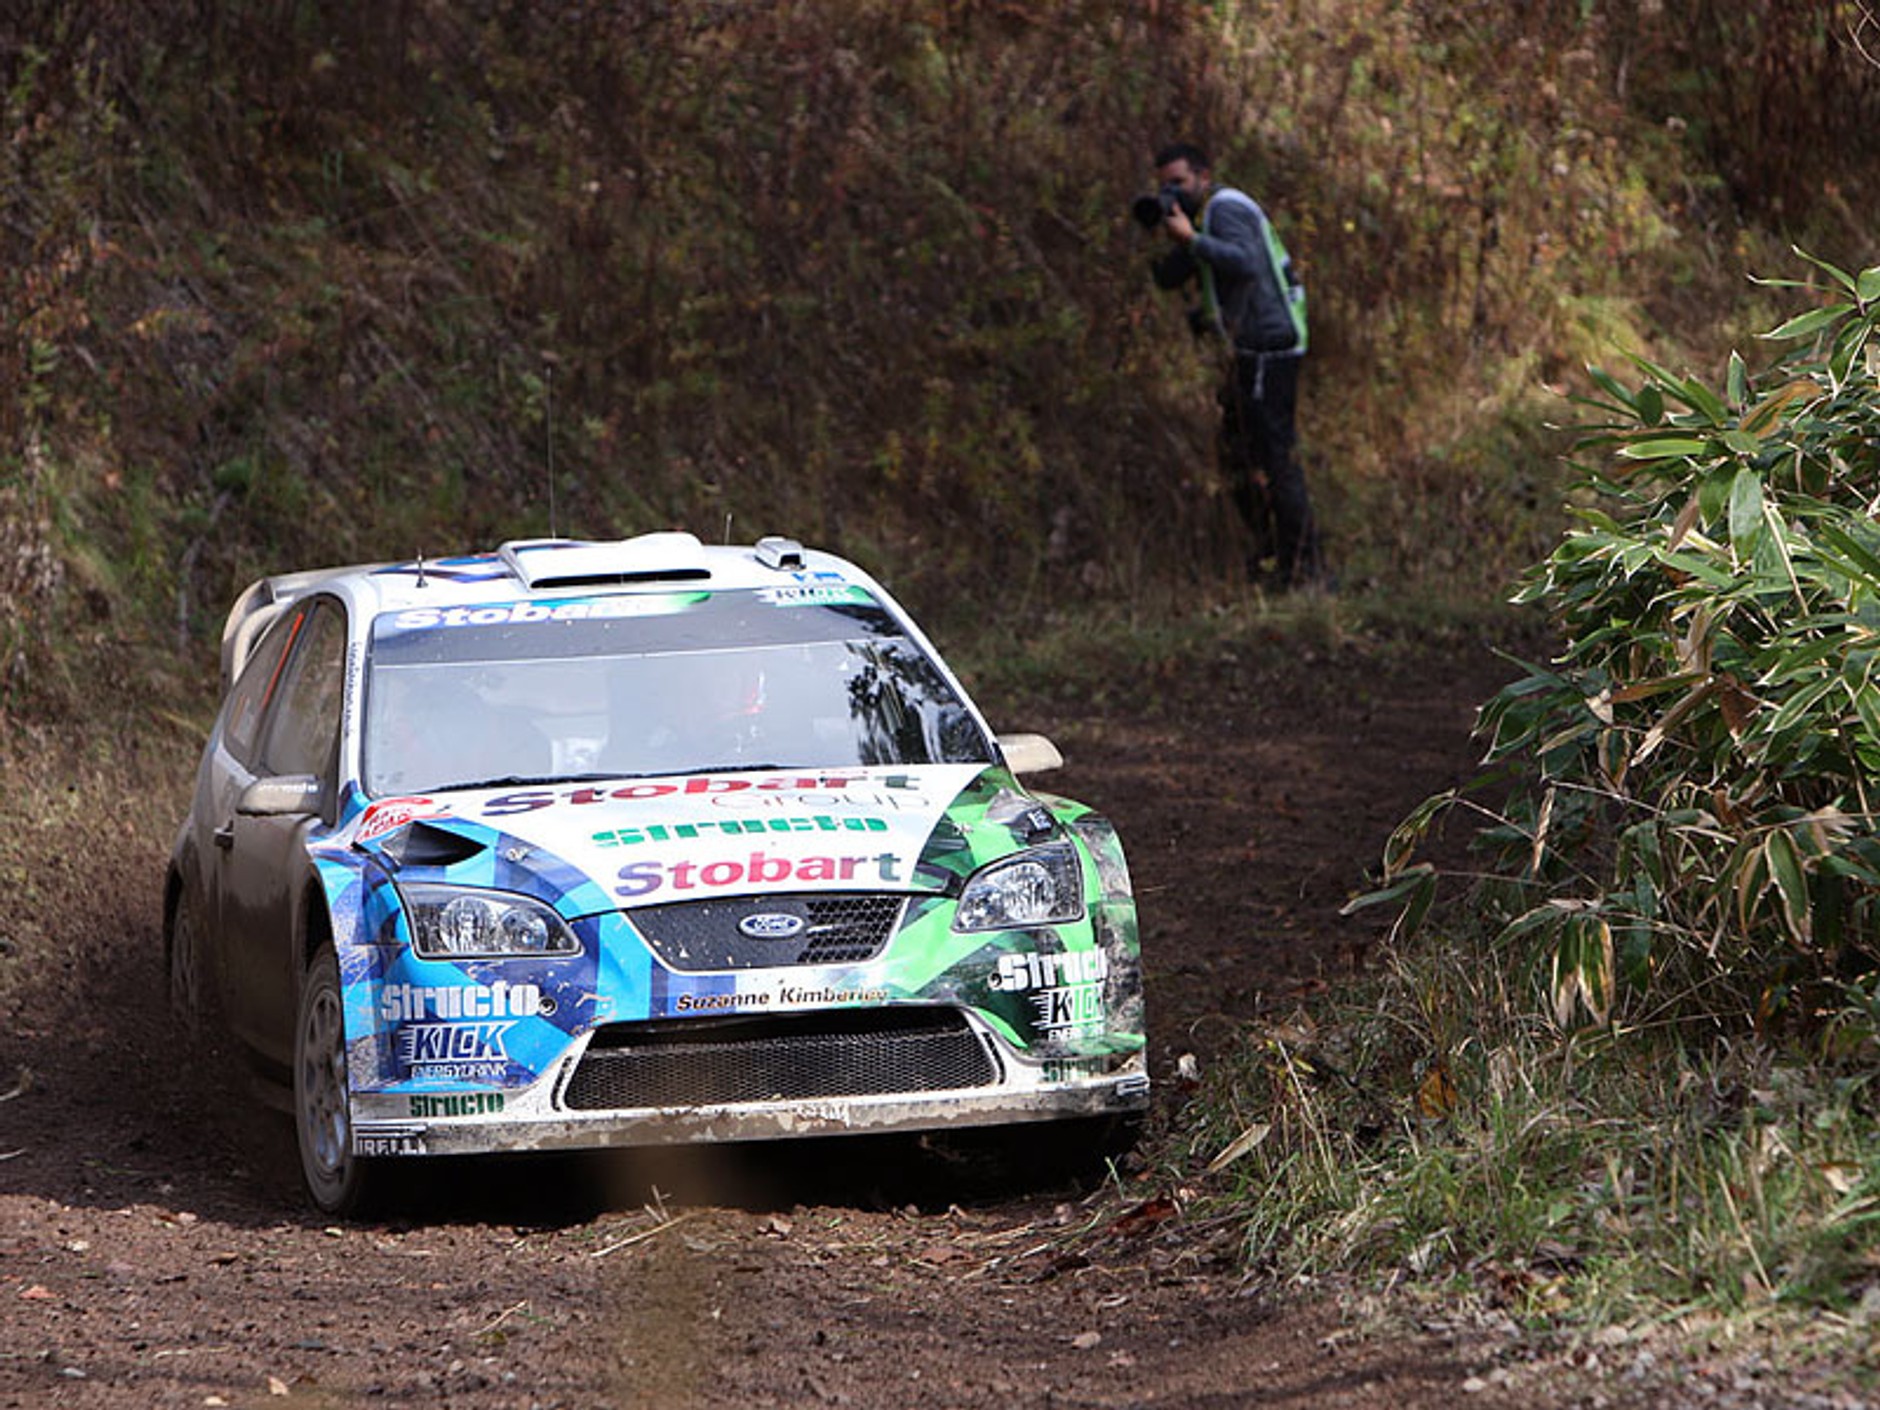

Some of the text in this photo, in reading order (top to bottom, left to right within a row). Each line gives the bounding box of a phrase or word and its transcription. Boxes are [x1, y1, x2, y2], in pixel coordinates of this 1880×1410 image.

[481, 774, 921, 817] Stobart
[613, 851, 901, 897] Stobart
[676, 993, 770, 1011] Suzanne
[412, 1025, 507, 1060] KICK
